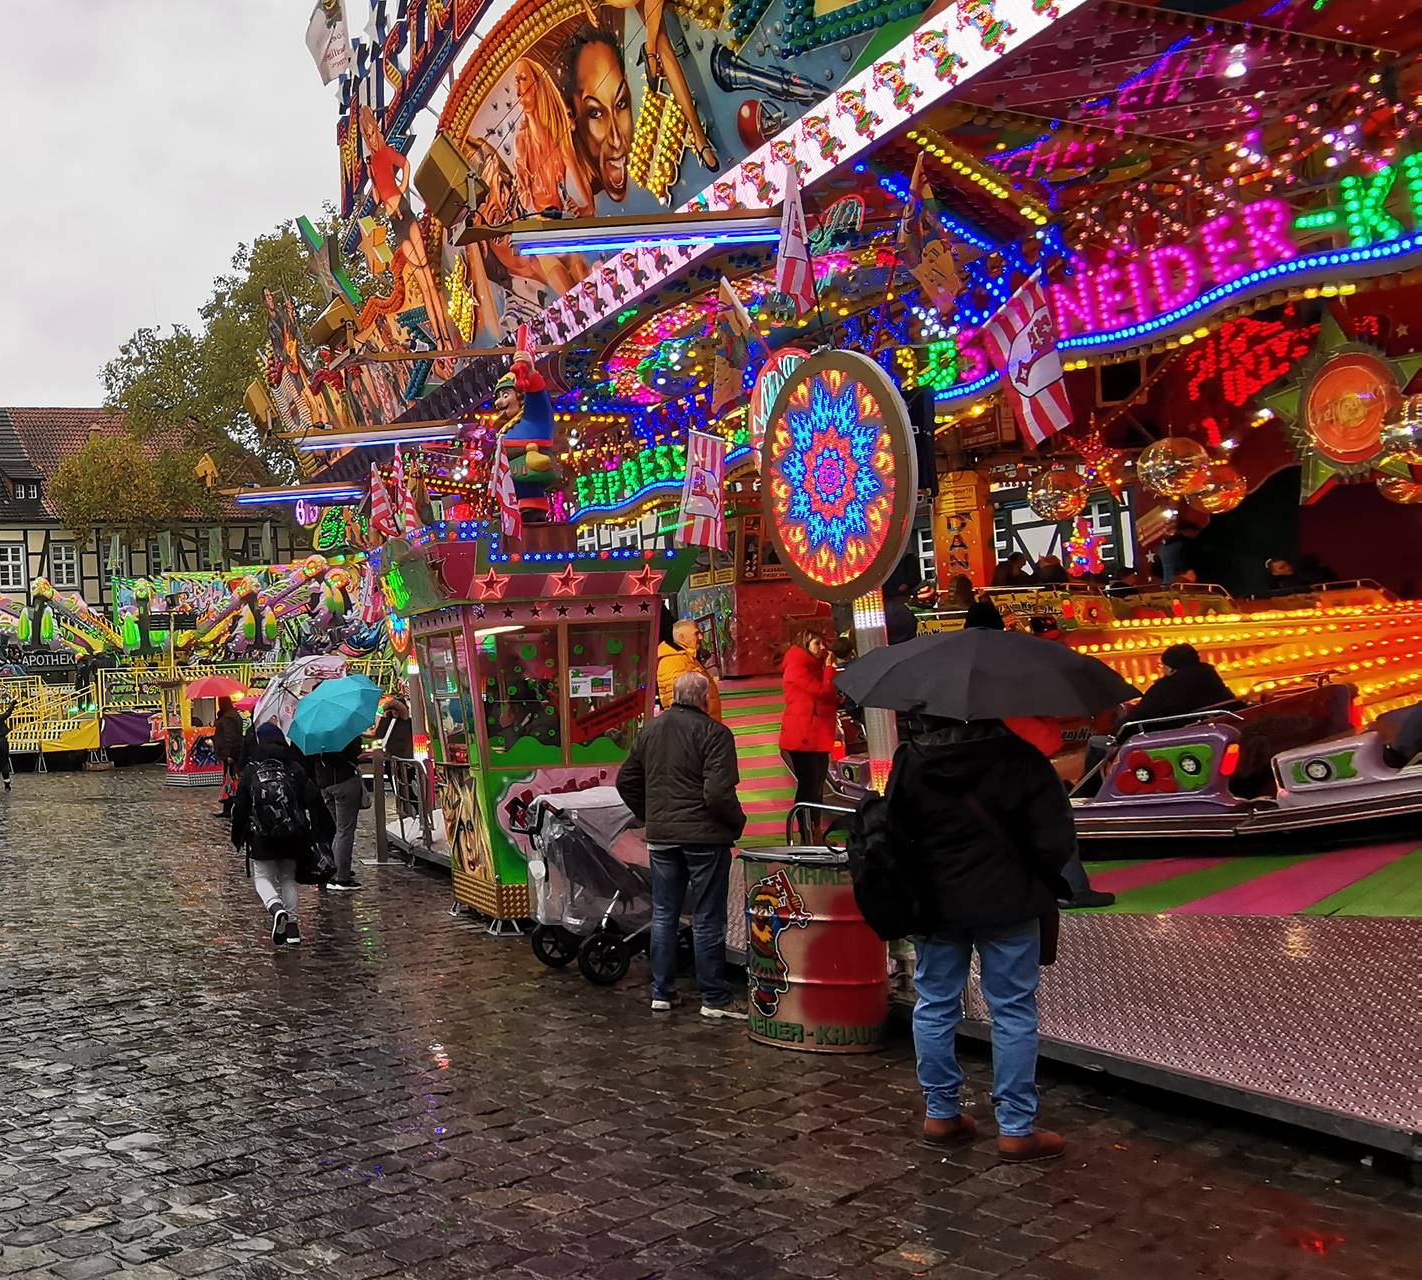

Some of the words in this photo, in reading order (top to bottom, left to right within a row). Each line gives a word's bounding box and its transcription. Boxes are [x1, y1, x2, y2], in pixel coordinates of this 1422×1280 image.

[576, 444, 686, 507] EXPRESS
[22, 652, 78, 667] APOTHEK
[787, 864, 852, 887] KIRME
